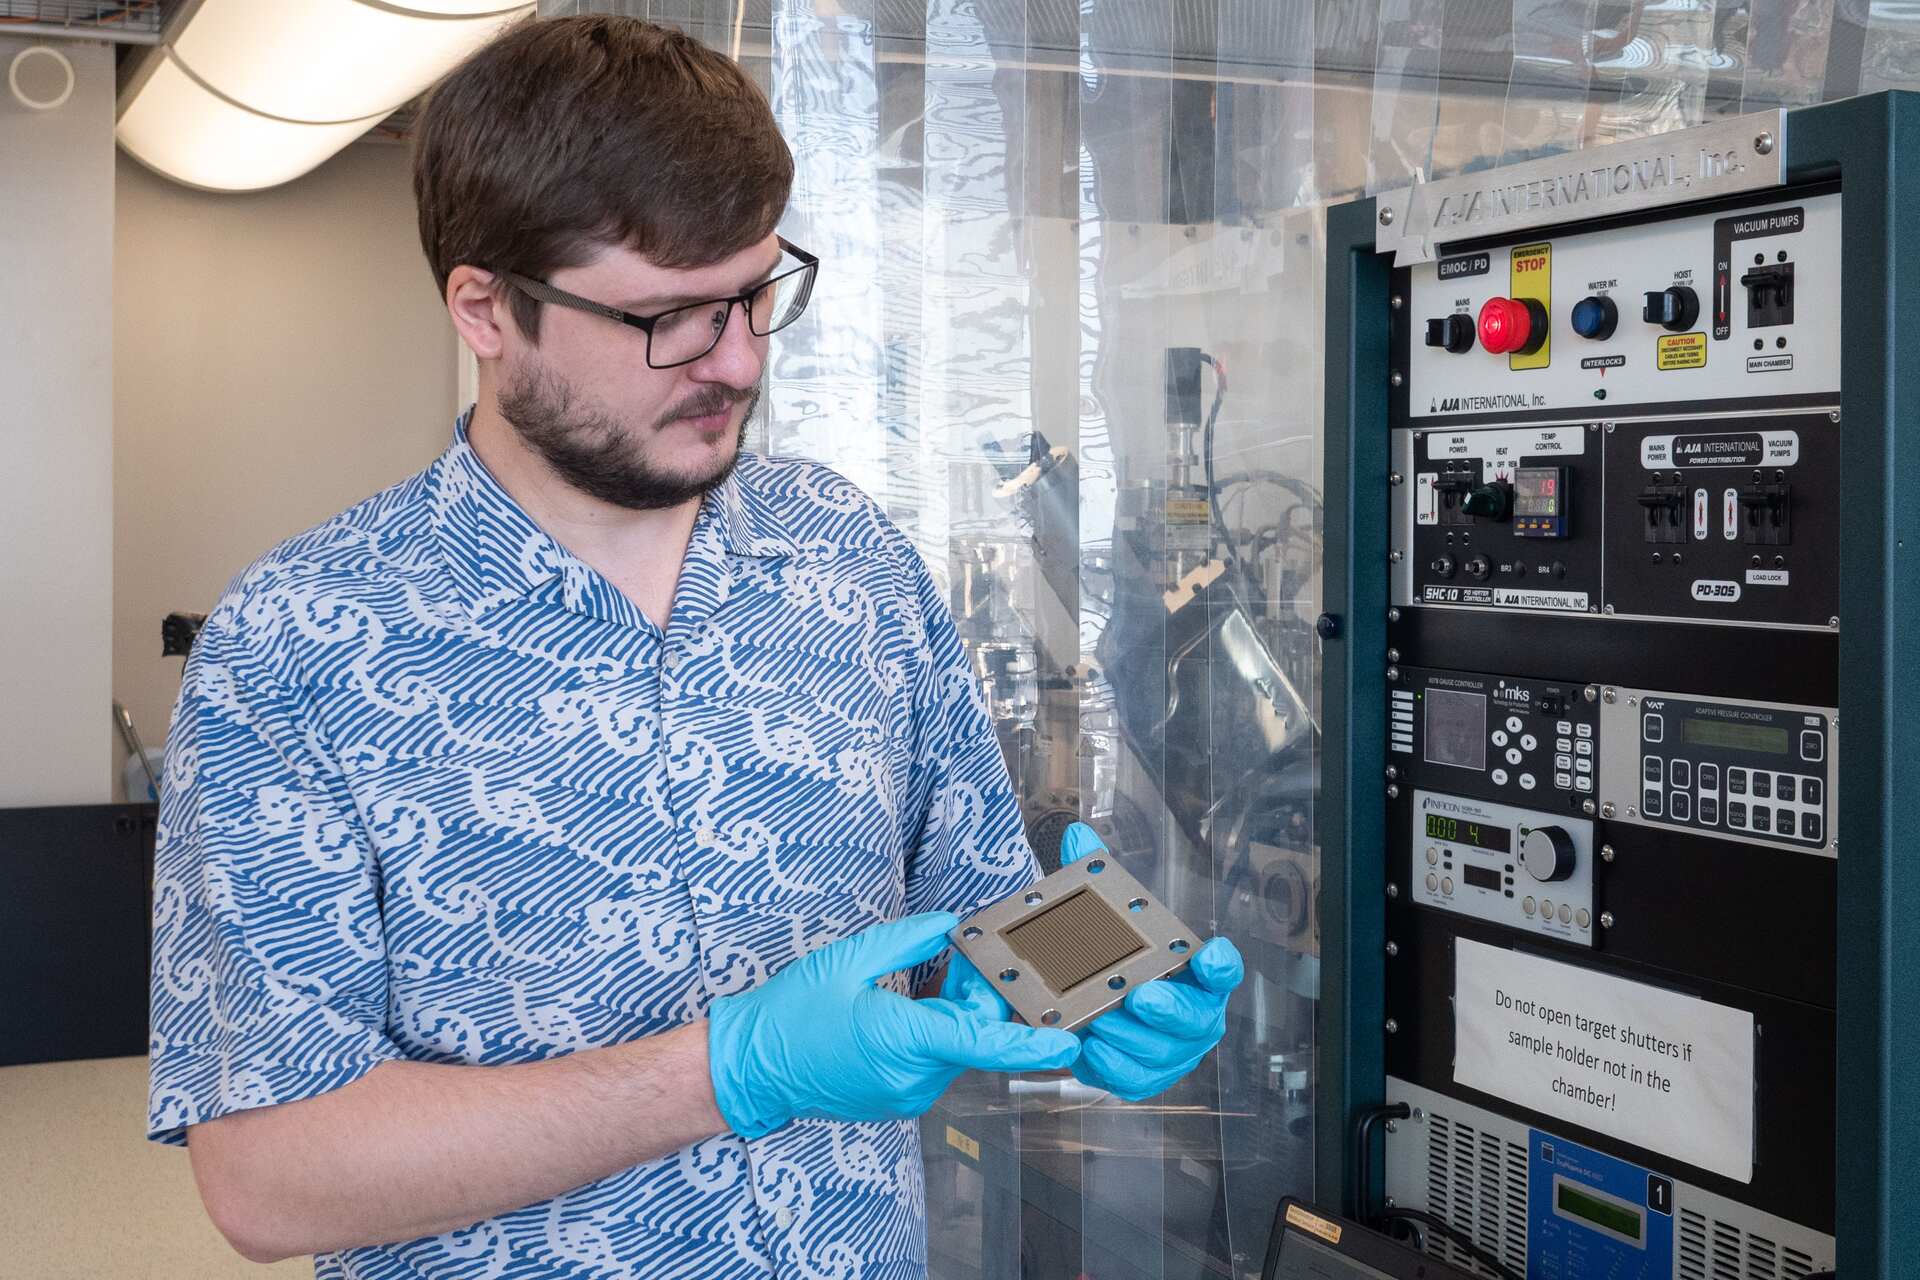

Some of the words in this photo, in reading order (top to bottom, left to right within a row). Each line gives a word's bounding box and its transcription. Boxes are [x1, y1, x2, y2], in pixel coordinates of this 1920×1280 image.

[1490, 154, 1691, 219] INTERNATIONAL,
[1699, 148, 1746, 180] Inc.
[1733, 219, 1769, 234] VACUUM
[1769, 214, 1799, 230] PUMPS
[1513, 246, 1549, 258] EMERGENCY
[1440, 263, 1467, 275] EMOC
[1474, 257, 1488, 270] PD
[1515, 257, 1546, 273] STOP
[1717, 261, 1728, 271] ON
[1673, 269, 1692, 279] HOIST
[1588, 280, 1608, 291] WATER
[1715, 326, 1729, 336] OFF
[1666, 337, 1696, 347] CAUTION
[1583, 358, 1623, 368] INTERLOCKS
[1763, 359, 1790, 368] CHAMBER
[1440, 398, 1460, 412] AJA
[1461, 394, 1530, 411] INTERNATIONAL,
[1532, 393, 1547, 406] Inc.
[1535, 442, 1562, 451] CONTROL
[1684, 443, 1702, 454] AJA
[1703, 440, 1760, 453] INTERNATIONAL
[1767, 439, 1793, 447] VACUUM
[1495, 447, 1508, 455] HEAT
[1770, 449, 1791, 457] PUMPS
[1647, 453, 1667, 461] POWER
[1689, 456, 1709, 464] POWER
[1709, 456, 1747, 464] DISTRIBUTION
[1496, 460, 1505, 468] OFF
[1538, 566, 1550, 574] BR4
[1425, 587, 1459, 601] SHC-10
[1504, 595, 1520, 605] AJA
[1521, 595, 1573, 608] INTERNATIONAL,
[1454, 680, 1483, 689] CONTROLLER
[1505, 686, 1530, 702] mks
[1646, 701, 1665, 710] VAT
[1695, 706, 1717, 716] ADAPTIVE
[1717, 708, 1740, 718] PRESSURE
[1740, 711, 1773, 721] CONTROLLER
[1430, 799, 1460, 813] INFICON
[1495, 989, 1512, 1009] Do
[1515, 998, 1536, 1017] not
[1538, 1006, 1571, 1028] open
[1575, 1013, 1617, 1040] target
[1620, 1026, 1679, 1058] shutters
[1682, 1043, 1693, 1062] if
[1508, 1030, 1553, 1055] sample
[1556, 1040, 1600, 1070] holder
[1603, 1059, 1627, 1079] not
[1630, 1064, 1643, 1084] in
[1647, 1070, 1671, 1093] the
[1551, 1076, 1616, 1111] chamber!
[1656, 1184, 1663, 1205] 1
